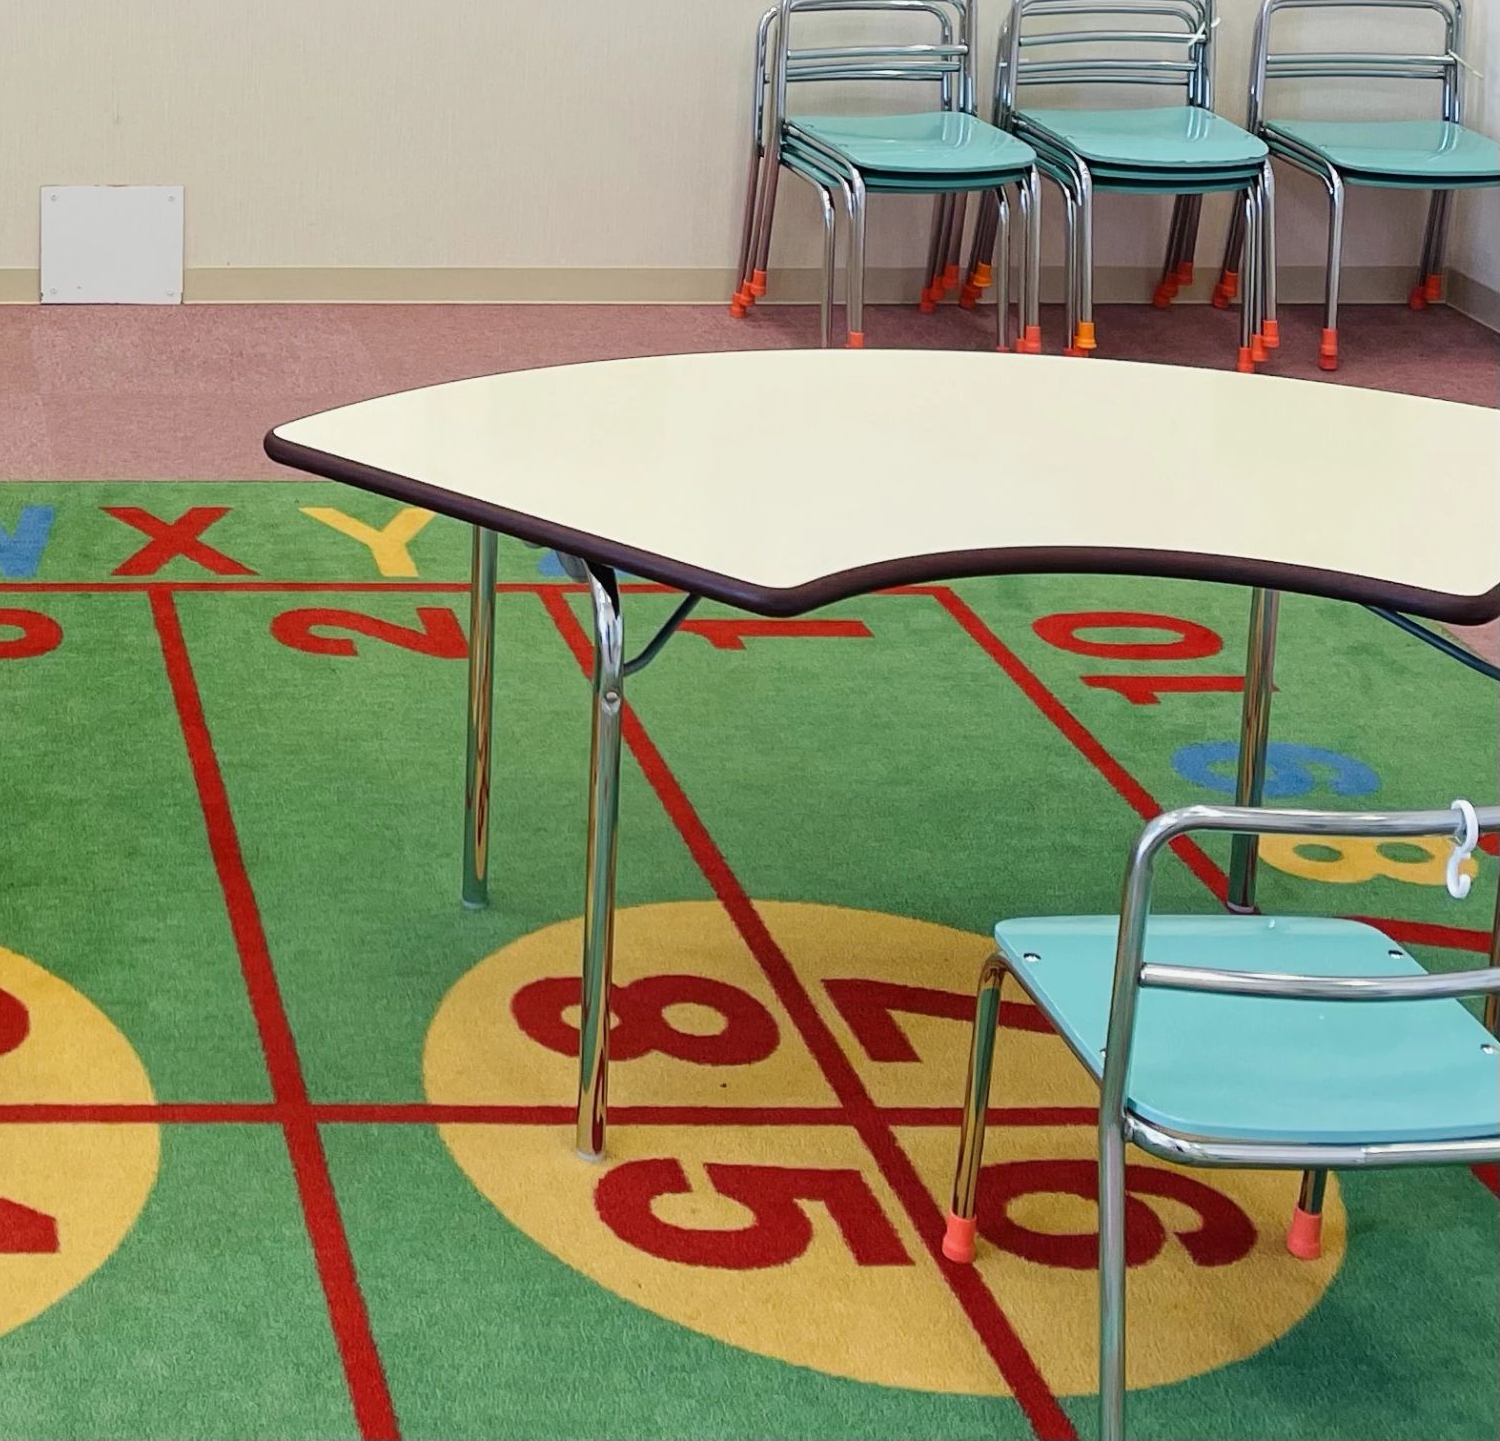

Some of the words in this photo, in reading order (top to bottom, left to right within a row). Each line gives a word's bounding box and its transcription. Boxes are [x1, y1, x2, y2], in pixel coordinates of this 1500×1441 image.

[103, 506, 261, 576] X
[301, 507, 438, 576] Y
[270, 606, 471, 660] 2
[510, 974, 779, 1067] 8
[594, 1158, 917, 1270] 5
